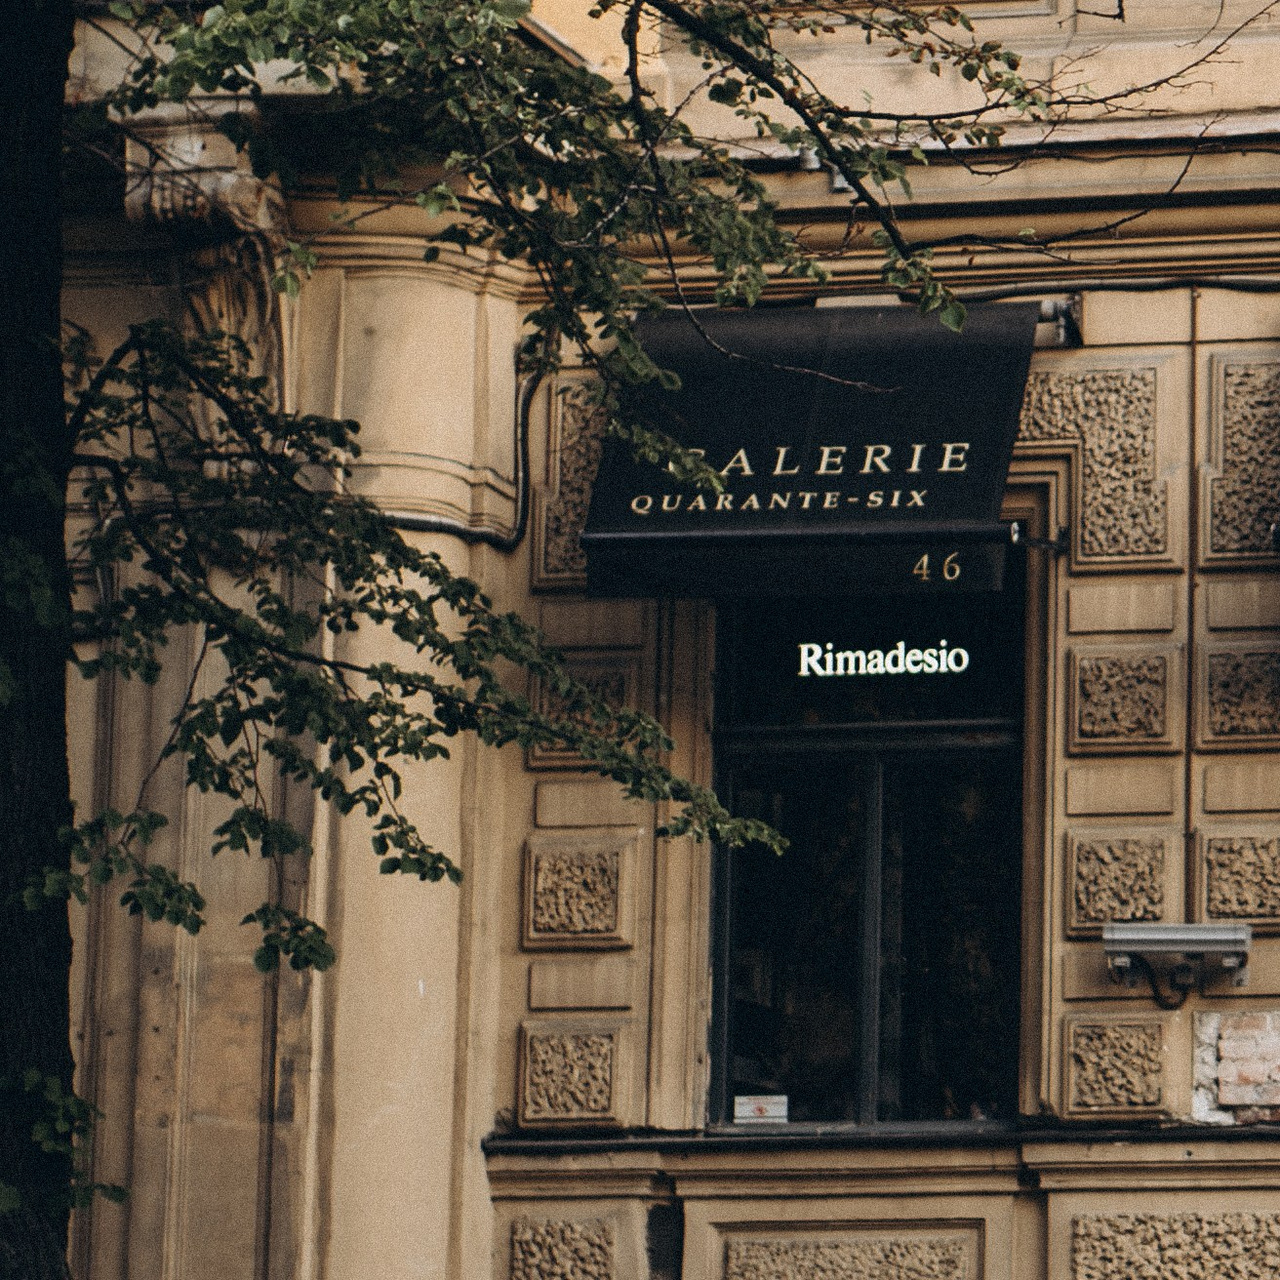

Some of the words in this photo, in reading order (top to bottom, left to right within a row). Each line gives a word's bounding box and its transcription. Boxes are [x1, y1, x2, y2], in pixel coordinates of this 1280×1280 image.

[630, 489, 928, 515] QUARANTE-SIX
[913, 552, 962, 581] 46
[797, 639, 970, 677] Rimadesio
